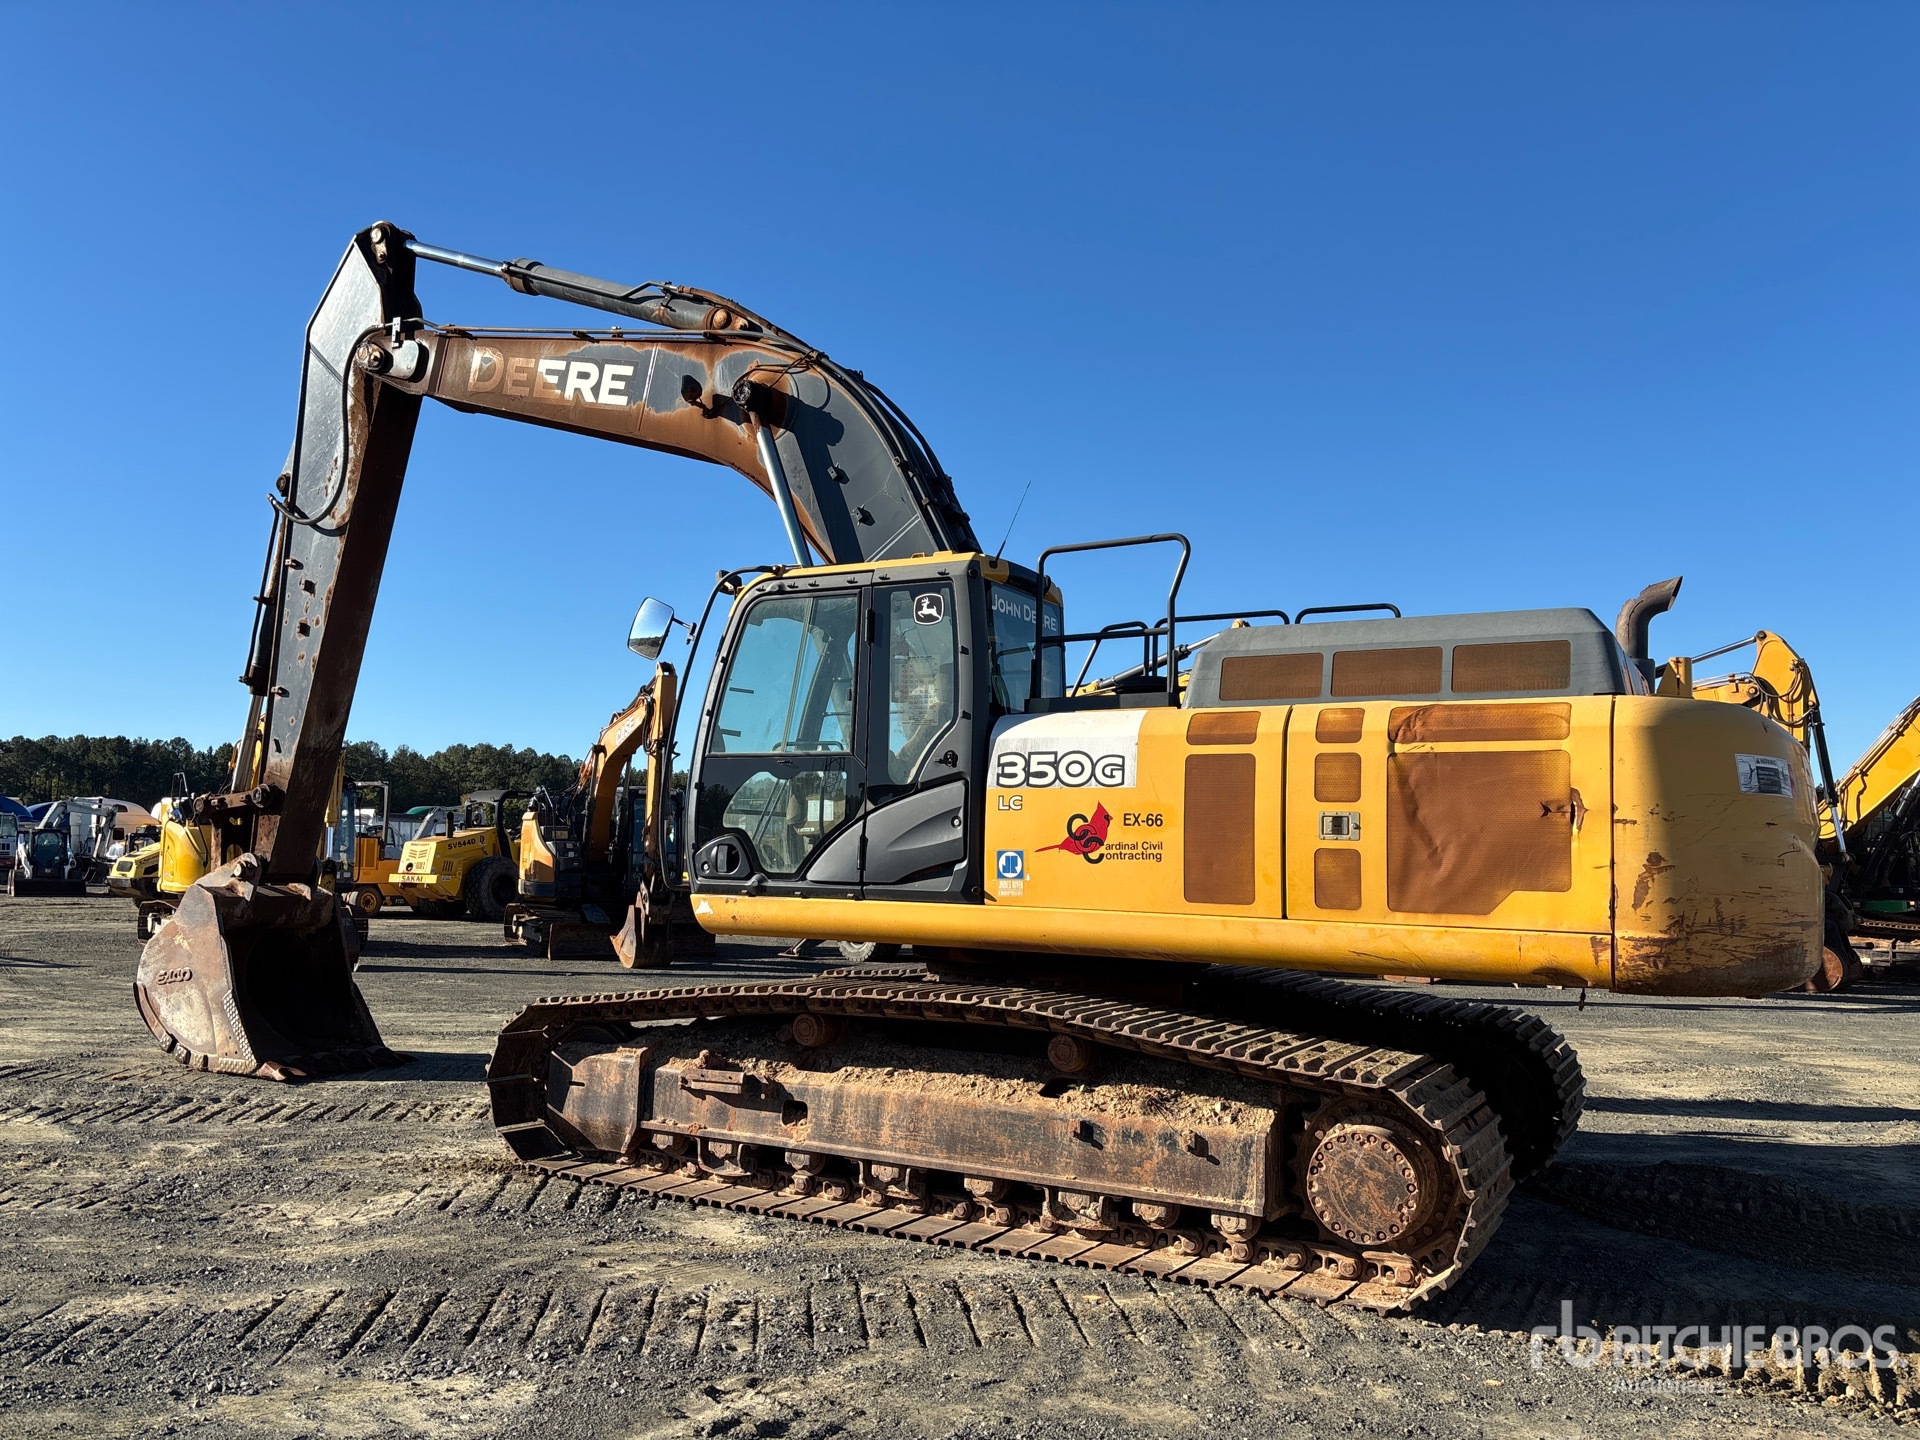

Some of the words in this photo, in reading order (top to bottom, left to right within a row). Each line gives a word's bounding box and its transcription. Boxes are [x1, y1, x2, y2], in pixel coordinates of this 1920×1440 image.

[467, 346, 634, 406] DEERE
[992, 594, 1021, 618] JOHN
[1023, 604, 1057, 631] DERE
[996, 750, 1125, 788] 350G
[998, 795, 1023, 811] LC
[1123, 813, 1163, 827] EX-66
[447, 838, 476, 850] SV544D
[1141, 841, 1163, 850] Civil
